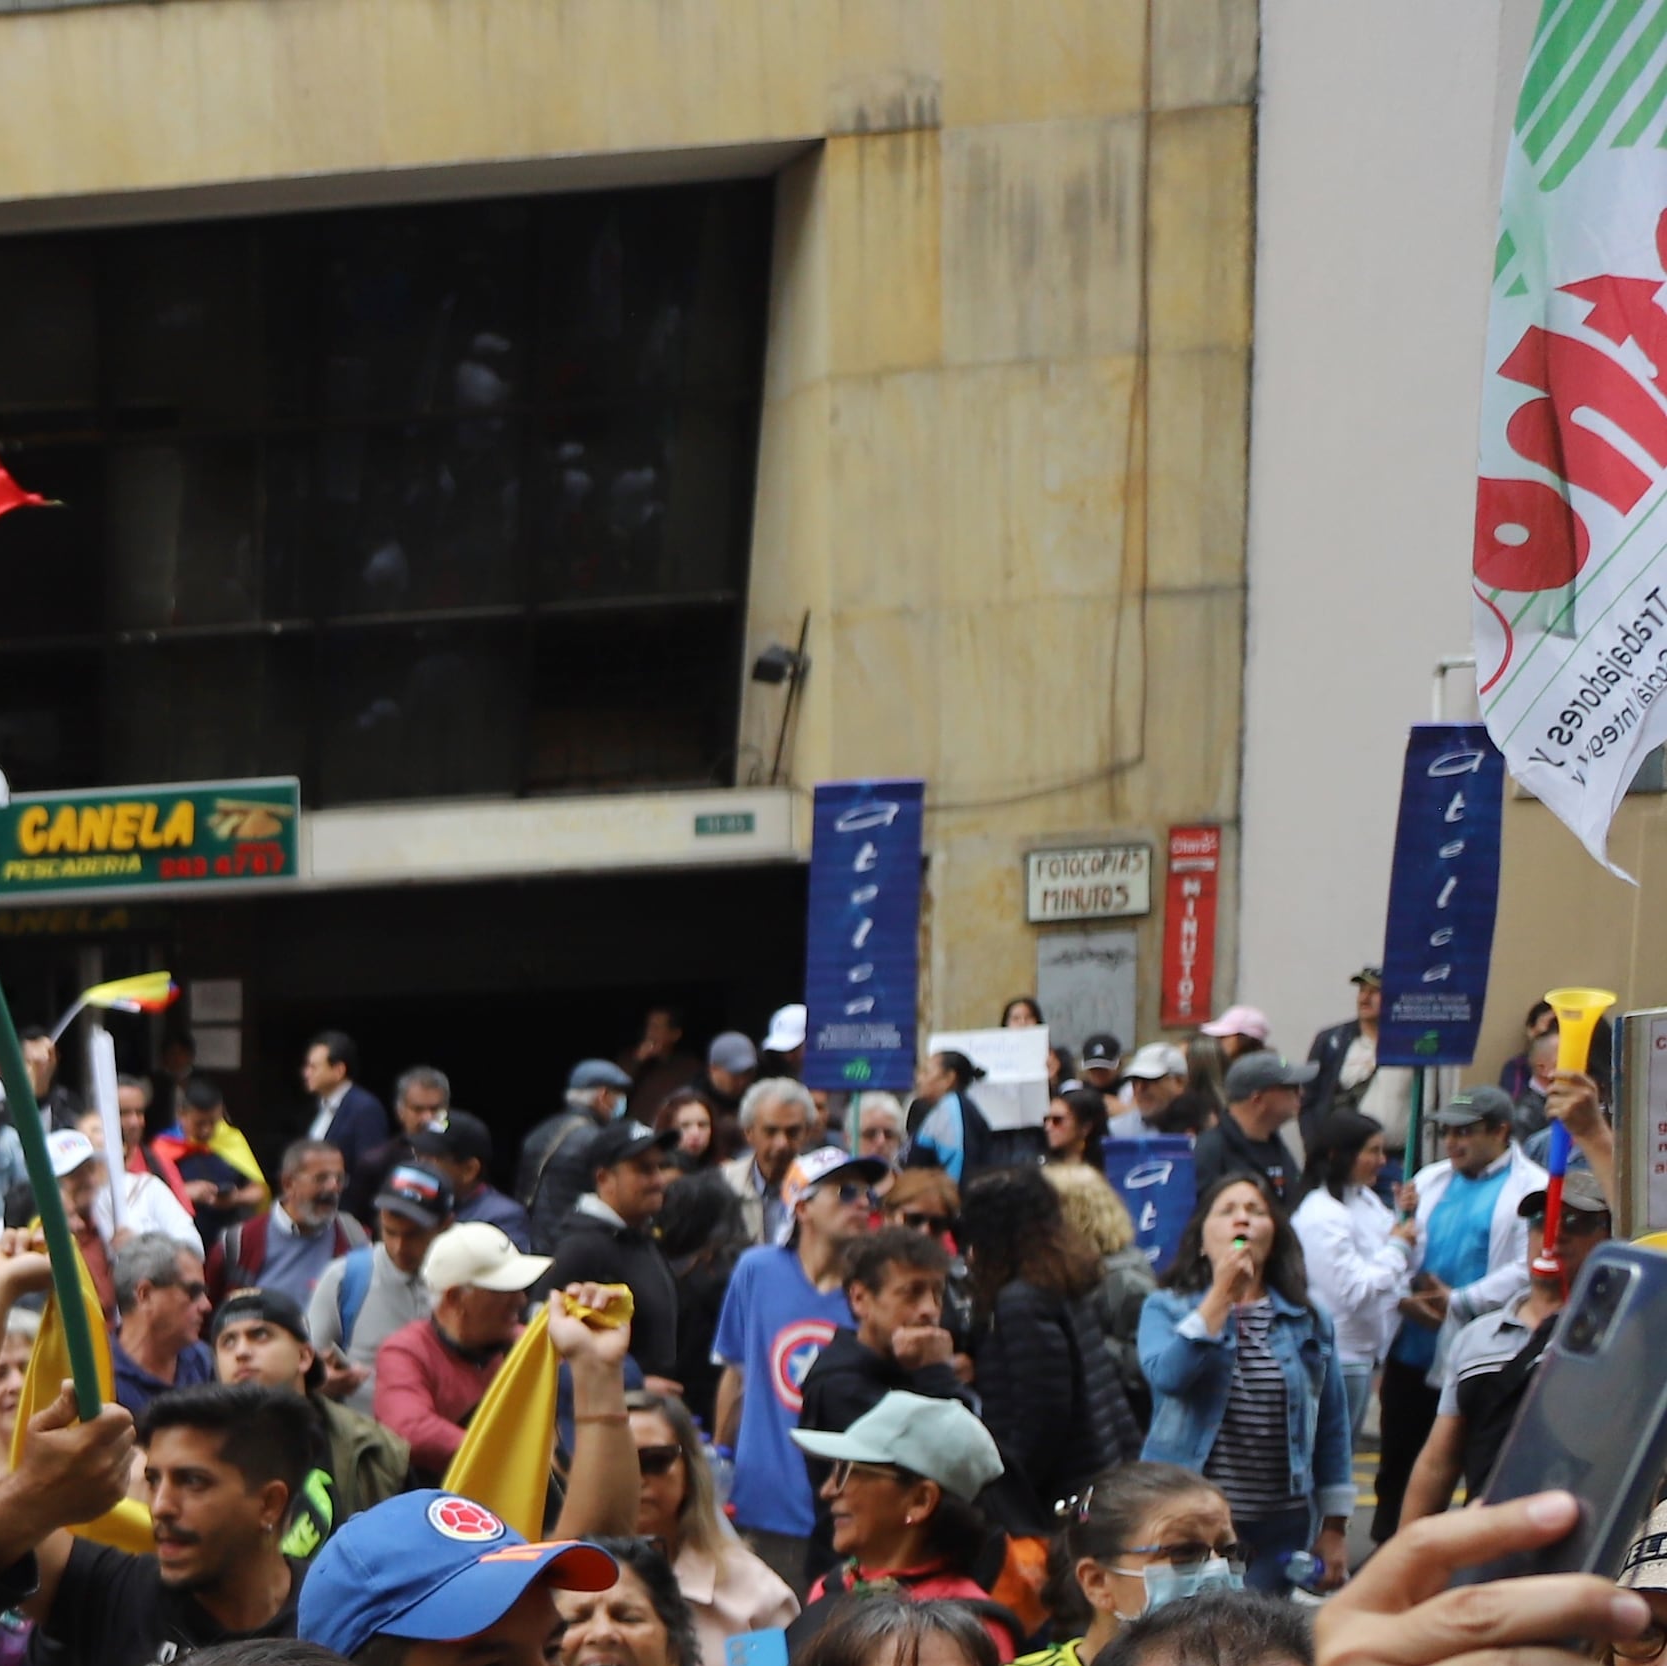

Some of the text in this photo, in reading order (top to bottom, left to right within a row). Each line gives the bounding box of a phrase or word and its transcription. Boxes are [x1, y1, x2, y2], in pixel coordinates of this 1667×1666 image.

[19, 800, 196, 855] CANELA
[1037, 852, 1144, 880] FOTOCOPIAS
[1043, 885, 1131, 912] MINUTOS
[1178, 878, 1202, 1017] MINUTOS
